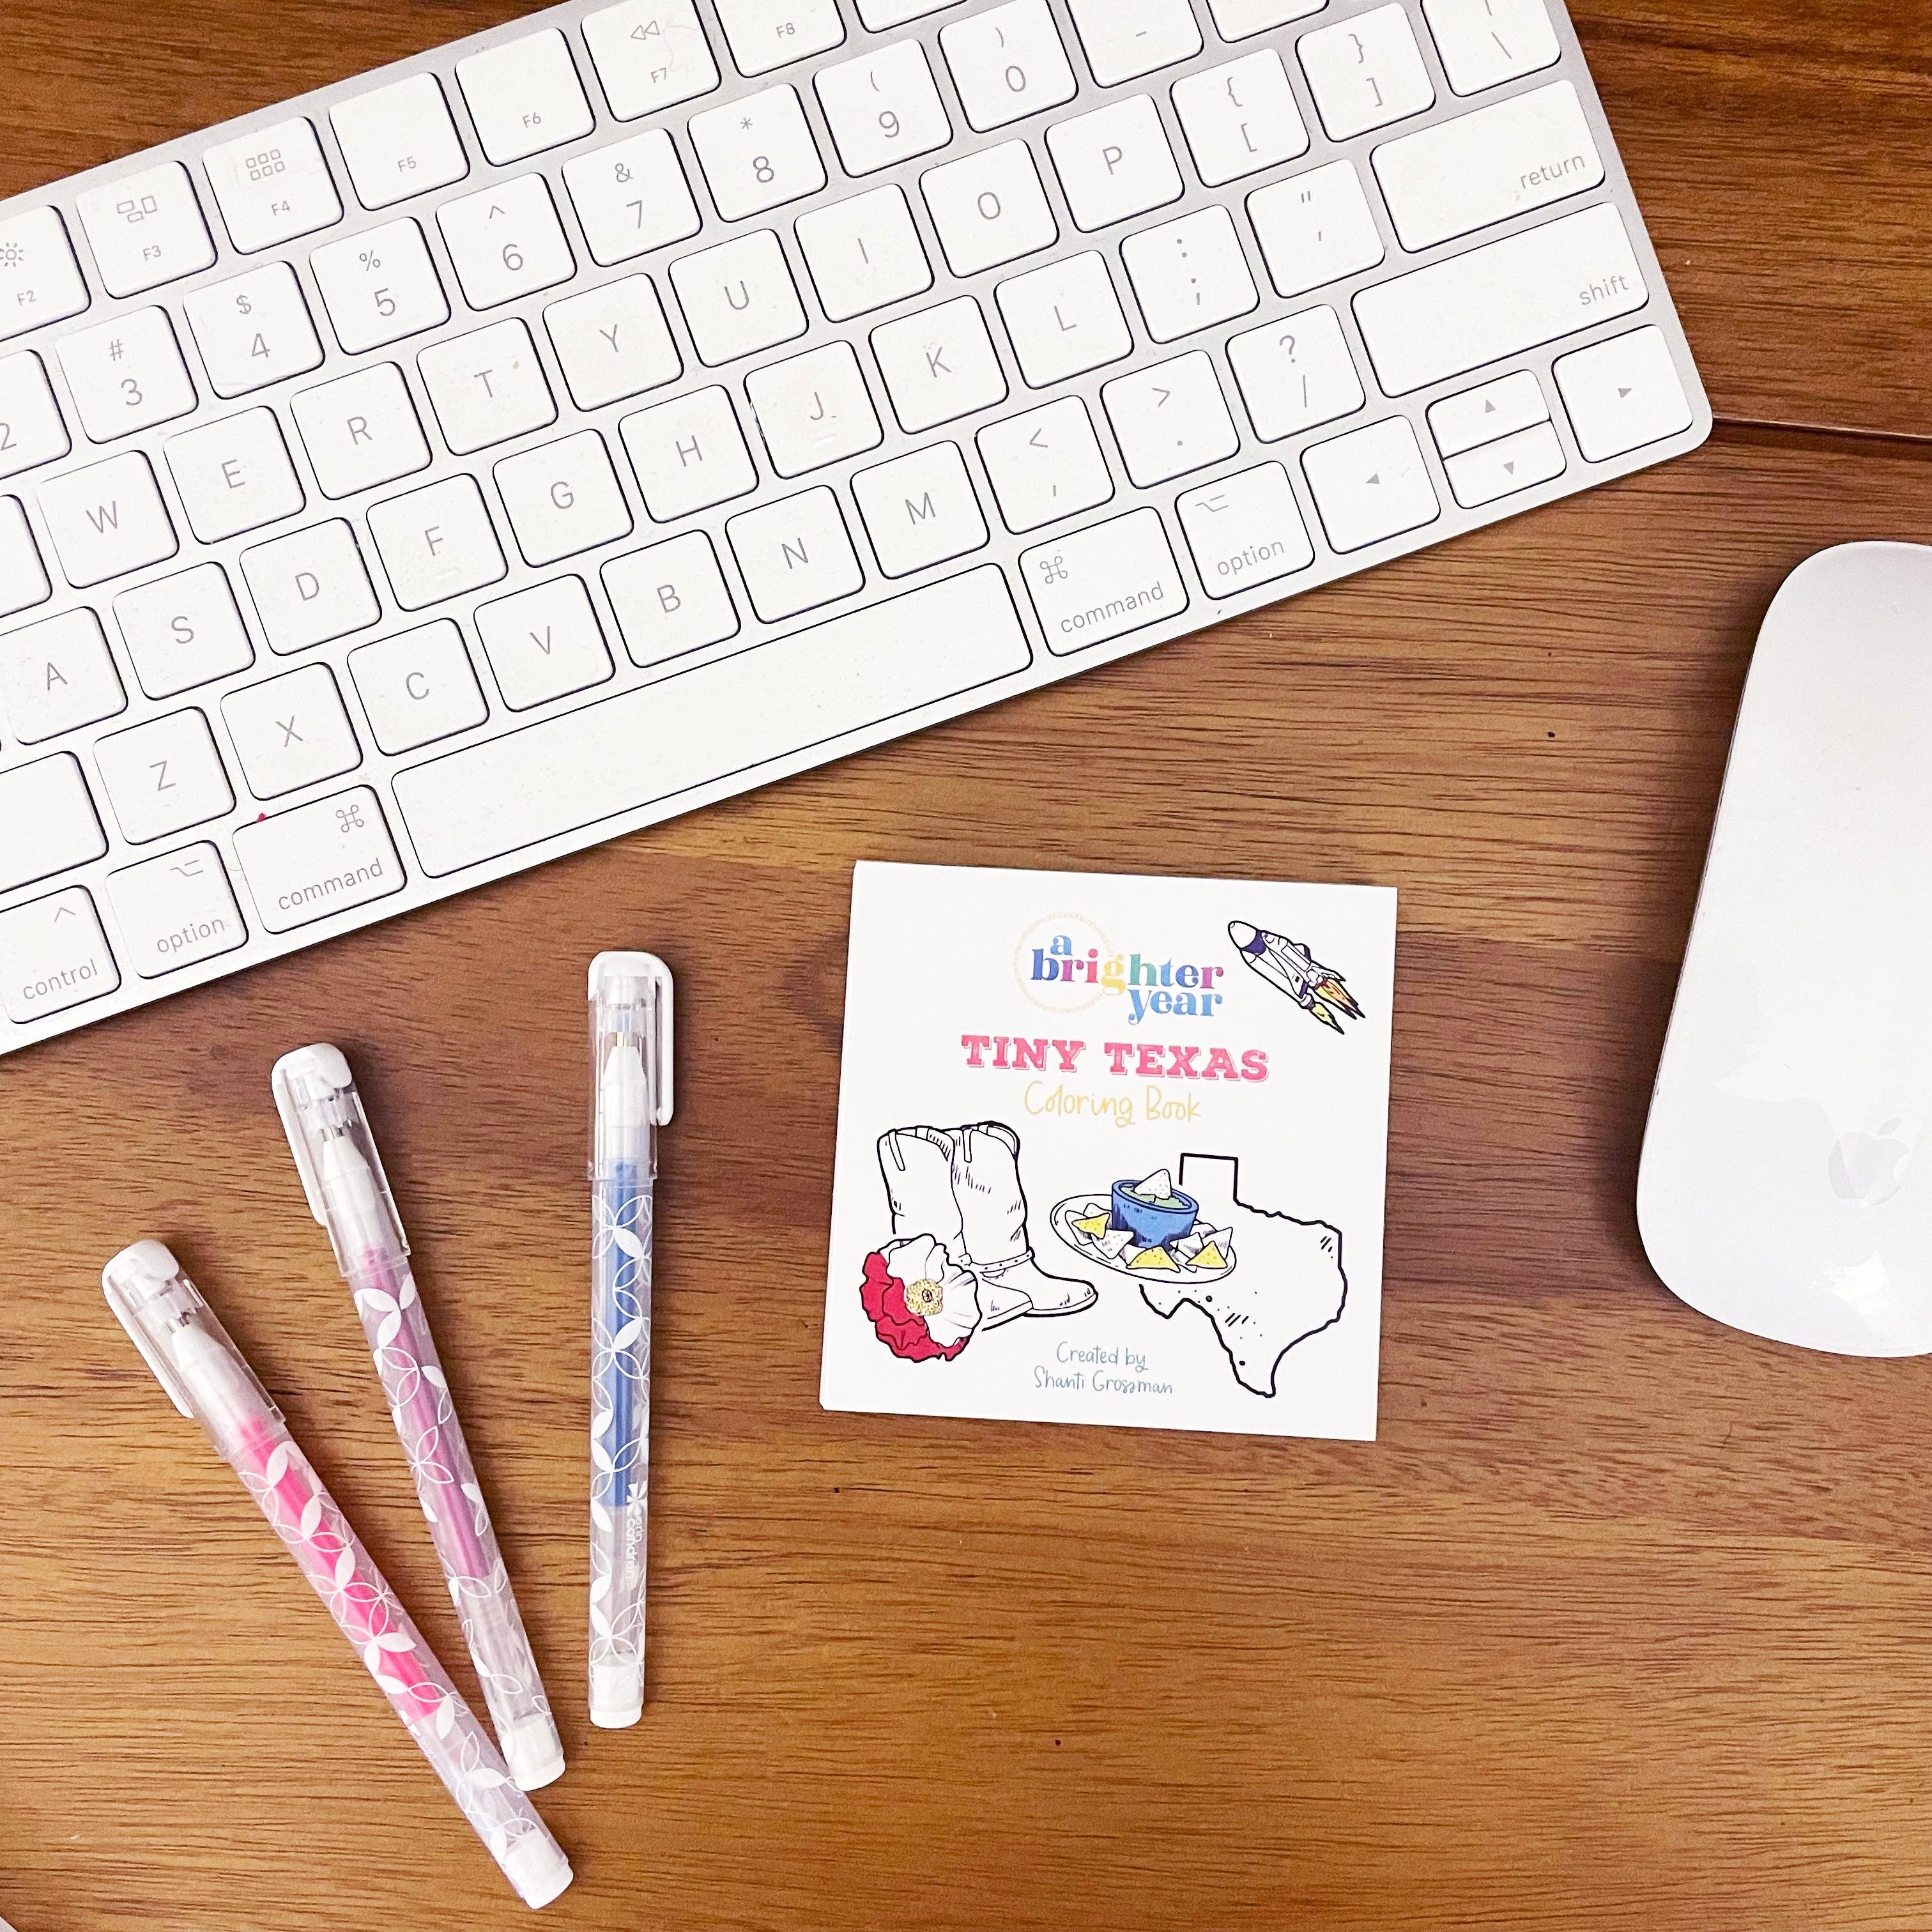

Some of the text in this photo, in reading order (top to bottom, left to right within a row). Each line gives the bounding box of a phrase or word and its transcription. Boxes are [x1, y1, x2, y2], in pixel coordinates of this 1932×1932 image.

[776, 23, 795, 38] F8
[995, 27, 1004, 48] )
[1348, 34, 1363, 64] }
[1491, 32, 1512, 59] \
[651, 67, 666, 83] F7
[870, 72, 880, 92] (
[1006, 66, 1026, 92] 0
[1227, 77, 1243, 107] {
[1366, 77, 1383, 107] ]
[523, 112, 541, 128] F6
[878, 111, 899, 138] 9
[1241, 123, 1257, 152] [
[398, 157, 416, 172] F5
[615, 164, 633, 183] &
[753, 156, 774, 183] 8
[1103, 146, 1123, 174] P
[1521, 156, 1585, 189] return
[271, 201, 290, 216] F4
[977, 192, 1001, 220] O
[1301, 191, 1310, 203] "
[489, 206, 505, 219] ^
[627, 200, 642, 229] 7
[143, 245, 161, 261] F3
[359, 250, 380, 271] %
[503, 244, 523, 270] 6
[858, 238, 868, 264] I
[1177, 239, 1187, 257] :
[17, 290, 36, 306] F2
[236, 295, 251, 314] $
[374, 288, 395, 316] 5
[724, 280, 749, 310] U
[1191, 279, 1200, 305] ;
[1580, 276, 1629, 305] shift
[1054, 305, 1077, 332] L
[109, 339, 123, 361] #
[252, 333, 270, 358] 4
[599, 324, 618, 353] Y
[1280, 335, 1296, 363] ?
[926, 347, 951, 378] K
[121, 379, 142, 406] 3
[473, 369, 493, 398] T
[1152, 388, 1170, 407] >
[810, 392, 824, 420] J
[0, 422, 17, 450] 2
[347, 417, 373, 445] R
[1029, 428, 1048, 448] <
[676, 435, 702, 467] H
[222, 459, 245, 489] E
[551, 482, 574, 509] G
[905, 492, 935, 525] M
[86, 501, 118, 533] W
[425, 526, 443, 556] F
[781, 538, 808, 569] N
[1217, 542, 1285, 575] option
[295, 572, 319, 601] D
[657, 585, 680, 613] B
[1061, 581, 1164, 632] command
[171, 616, 194, 644] S
[530, 626, 550, 655] V
[47, 663, 68, 691] A
[406, 672, 429, 700] C
[277, 716, 303, 747] X
[150, 760, 176, 791] Z
[279, 857, 383, 910] command
[157, 919, 225, 953] option
[1050, 935, 1073, 956] a
[23, 958, 97, 999] control
[1030, 948, 1224, 996] brighter
[1127, 989, 1223, 1025] year
[962, 1035, 1268, 1083] TINY TEXAS
[1024, 1080, 1201, 1128] Coloring Book
[1057, 1342, 1149, 1372] Created by
[1034, 1365, 1172, 1394] Shanti Grossman
